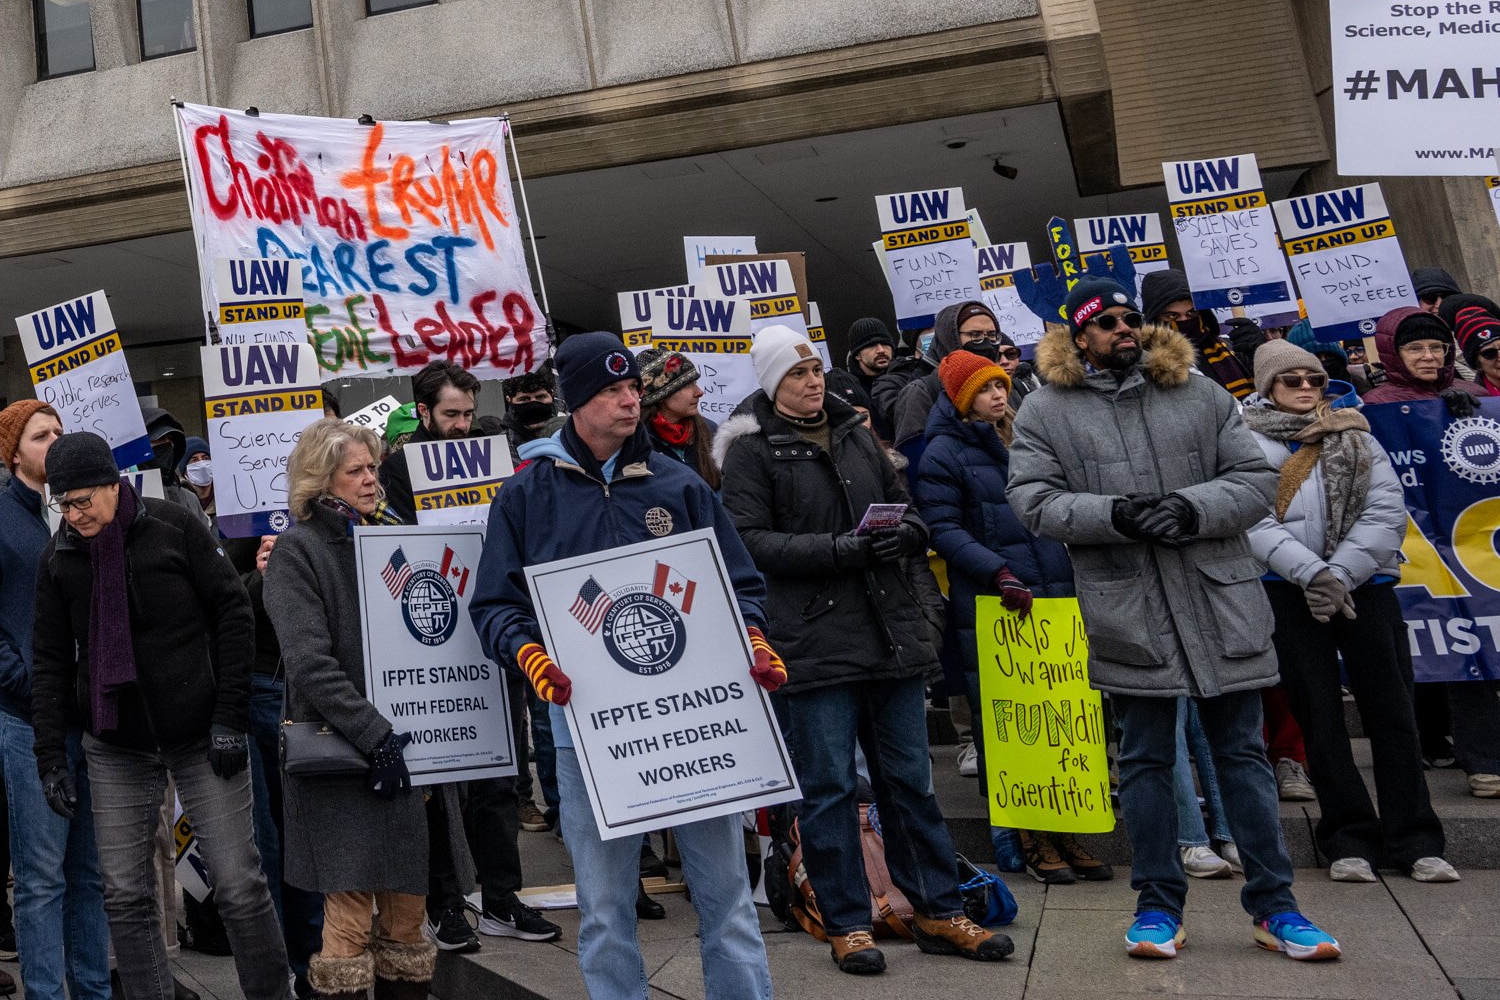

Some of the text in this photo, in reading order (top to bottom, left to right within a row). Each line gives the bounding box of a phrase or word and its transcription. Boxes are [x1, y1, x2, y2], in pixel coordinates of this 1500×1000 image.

[1390, 1, 1481, 18] Stop the
[1345, 20, 1500, 38] Science, Medic
[1343, 67, 1500, 101] #MAH
[1415, 147, 1495, 159] www.MA
[1176, 158, 1239, 195] UAW
[890, 190, 949, 224] UAW
[1176, 195, 1260, 217] STAND UP
[1290, 187, 1365, 230] UAW
[1089, 216, 1146, 245] UAW
[1188, 210, 1259, 238] SCIENCE
[888, 225, 965, 247] STAND UP
[1200, 232, 1258, 257] SAVES
[1292, 224, 1388, 254] STAND UP
[893, 251, 958, 275] FUND,
[978, 244, 1015, 274] AW
[1142, 248, 1161, 258] UP
[229, 260, 289, 295] UAW
[717, 262, 777, 296] UAW
[1208, 256, 1260, 279] LIVES
[909, 269, 954, 290] DON'T
[1321, 274, 1372, 294] DON'T
[775, 300, 795, 312] UP
[915, 286, 973, 304] FREEZE
[1340, 284, 1409, 307] FREEZE
[32, 296, 96, 350] UAW
[224, 305, 301, 322] STAND UP
[667, 299, 735, 332] UAW
[657, 342, 747, 353] STAND UP
[36, 338, 116, 382] STAND UP
[220, 344, 299, 386] UAW
[44, 364, 131, 410] Public research
[73, 392, 120, 424] serves
[213, 394, 317, 418] STAND UP
[371, 403, 390, 416] TO
[421, 438, 491, 481] UAW
[1465, 443, 1495, 457] UAW
[420, 490, 481, 511] STAND
[406, 571, 426, 593] CENTURY
[426, 571, 434, 579] OF
[613, 585, 649, 598] SOLIDARITY
[411, 602, 450, 612] IFPTE
[607, 595, 633, 621] CENTURY
[645, 594, 674, 616] SERVICE
[422, 636, 432, 644] EST
[616, 622, 674, 644] IFPTE
[383, 664, 490, 687] IFPTE STANDS
[639, 660, 672, 674] EST 1918
[1016, 660, 1084, 690] wanna
[391, 696, 488, 717] WITH FEDERAL
[590, 681, 744, 730] IFPTE STANDS
[410, 725, 477, 745] WORKERS
[608, 718, 748, 760] WITH FEDERAL
[638, 752, 736, 786] WORKERS
[996, 770, 1094, 817] Scientific
